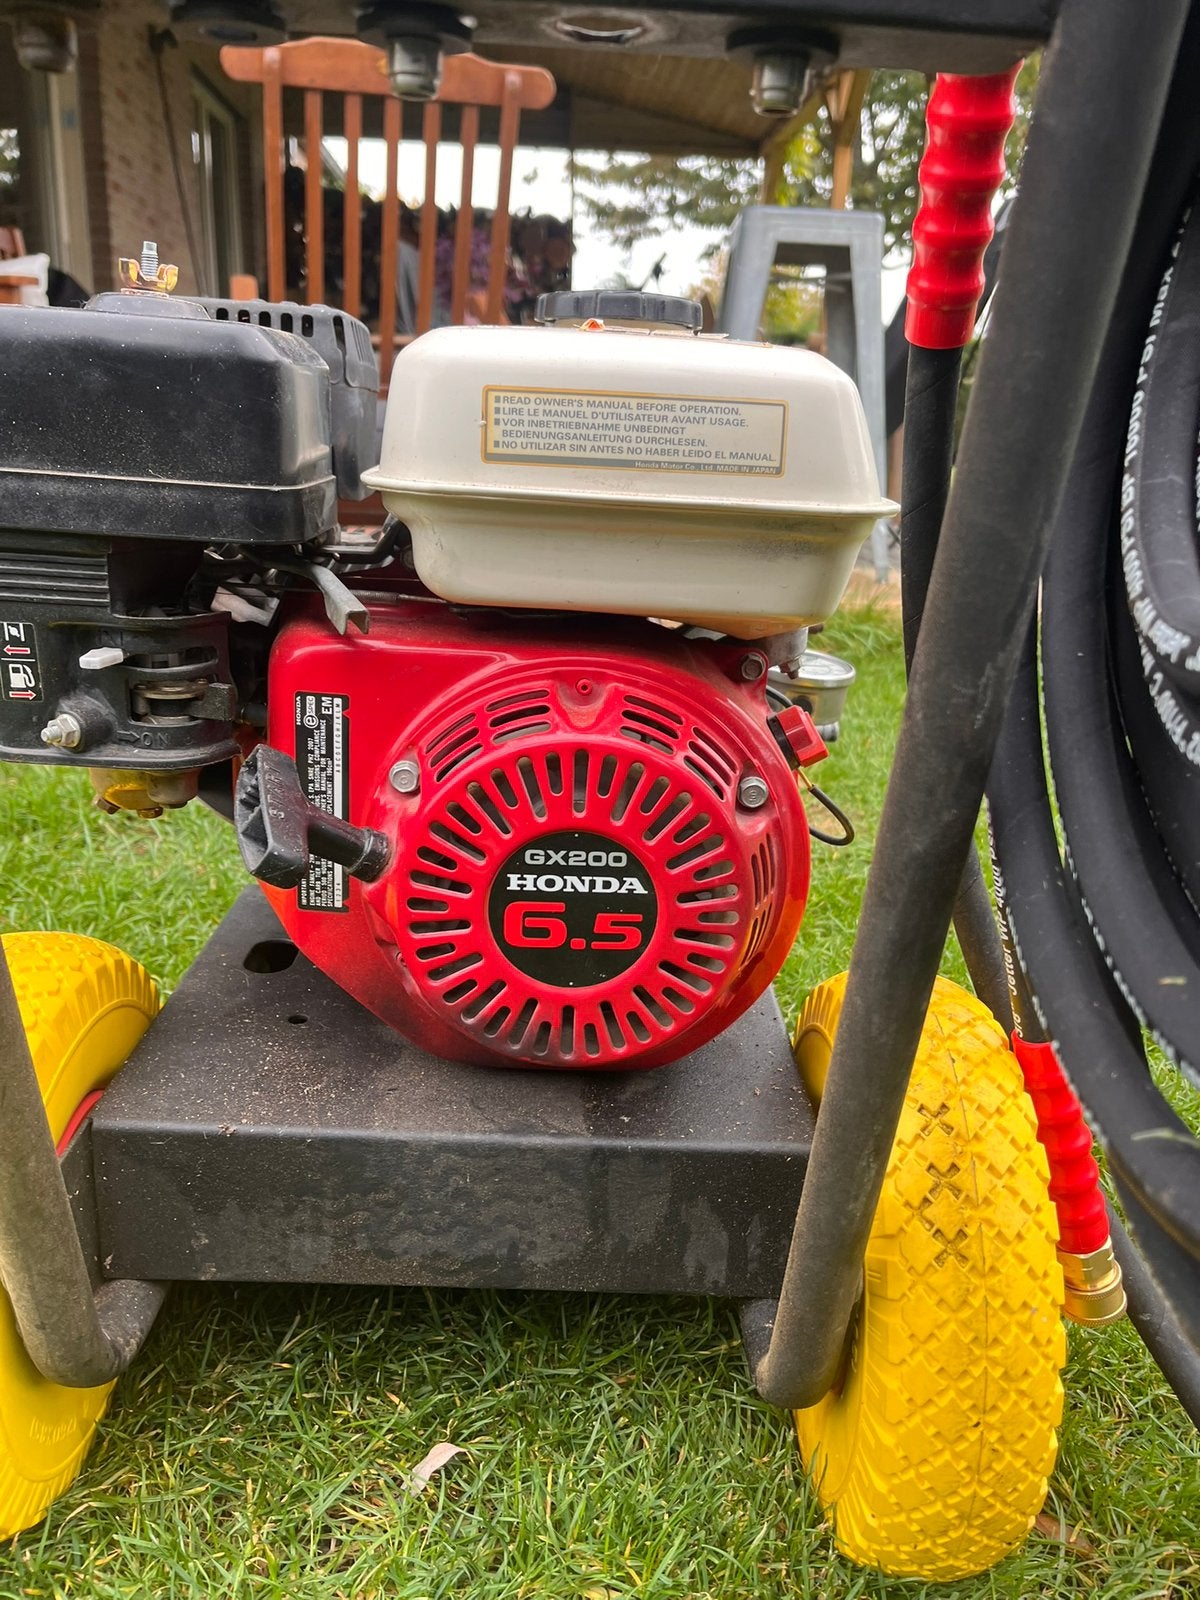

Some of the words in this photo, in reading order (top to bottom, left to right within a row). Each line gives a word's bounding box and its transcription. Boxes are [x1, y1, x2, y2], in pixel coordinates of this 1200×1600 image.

[502, 396, 531, 405] READ
[534, 397, 584, 408] OWNER'S
[587, 400, 634, 410] MANUAL
[636, 402, 676, 412] BEFORE
[680, 404, 742, 416] OPERATION.
[502, 407, 524, 416] LIRE
[528, 408, 540, 417] LE
[542, 409, 588, 419] MANUEL
[591, 412, 669, 423] D'UTILISATEUR
[671, 416, 706, 425] AVANT
[710, 418, 749, 428] USAGE.
[502, 418, 525, 427] VOR
[528, 420, 621, 432] INBETRIEBNAHME
[624, 424, 686, 435] UNBEDINGT
[502, 430, 632, 444] BEDIENUNGSANLEITUNG
[636, 436, 708, 447] DURCHLESEN.
[502, 440, 517, 449] NO
[520, 442, 566, 451] UTILIZAR
[569, 444, 587, 452] SIN
[589, 444, 624, 455] ANTES
[627, 447, 642, 455] NO
[645, 448, 680, 457] HABER
[682, 449, 712, 458] LEIDO
[715, 451, 726, 459] EL
[729, 452, 777, 462] MANUAL.
[322, 696, 332, 714] EM
[264, 761, 285, 820] START
[524, 849, 628, 868] GX200
[506, 874, 648, 894] HONDA
[504, 901, 643, 950] 6.5
[996, 910, 1008, 940] WP
[1004, 944, 1018, 996] Jetter
